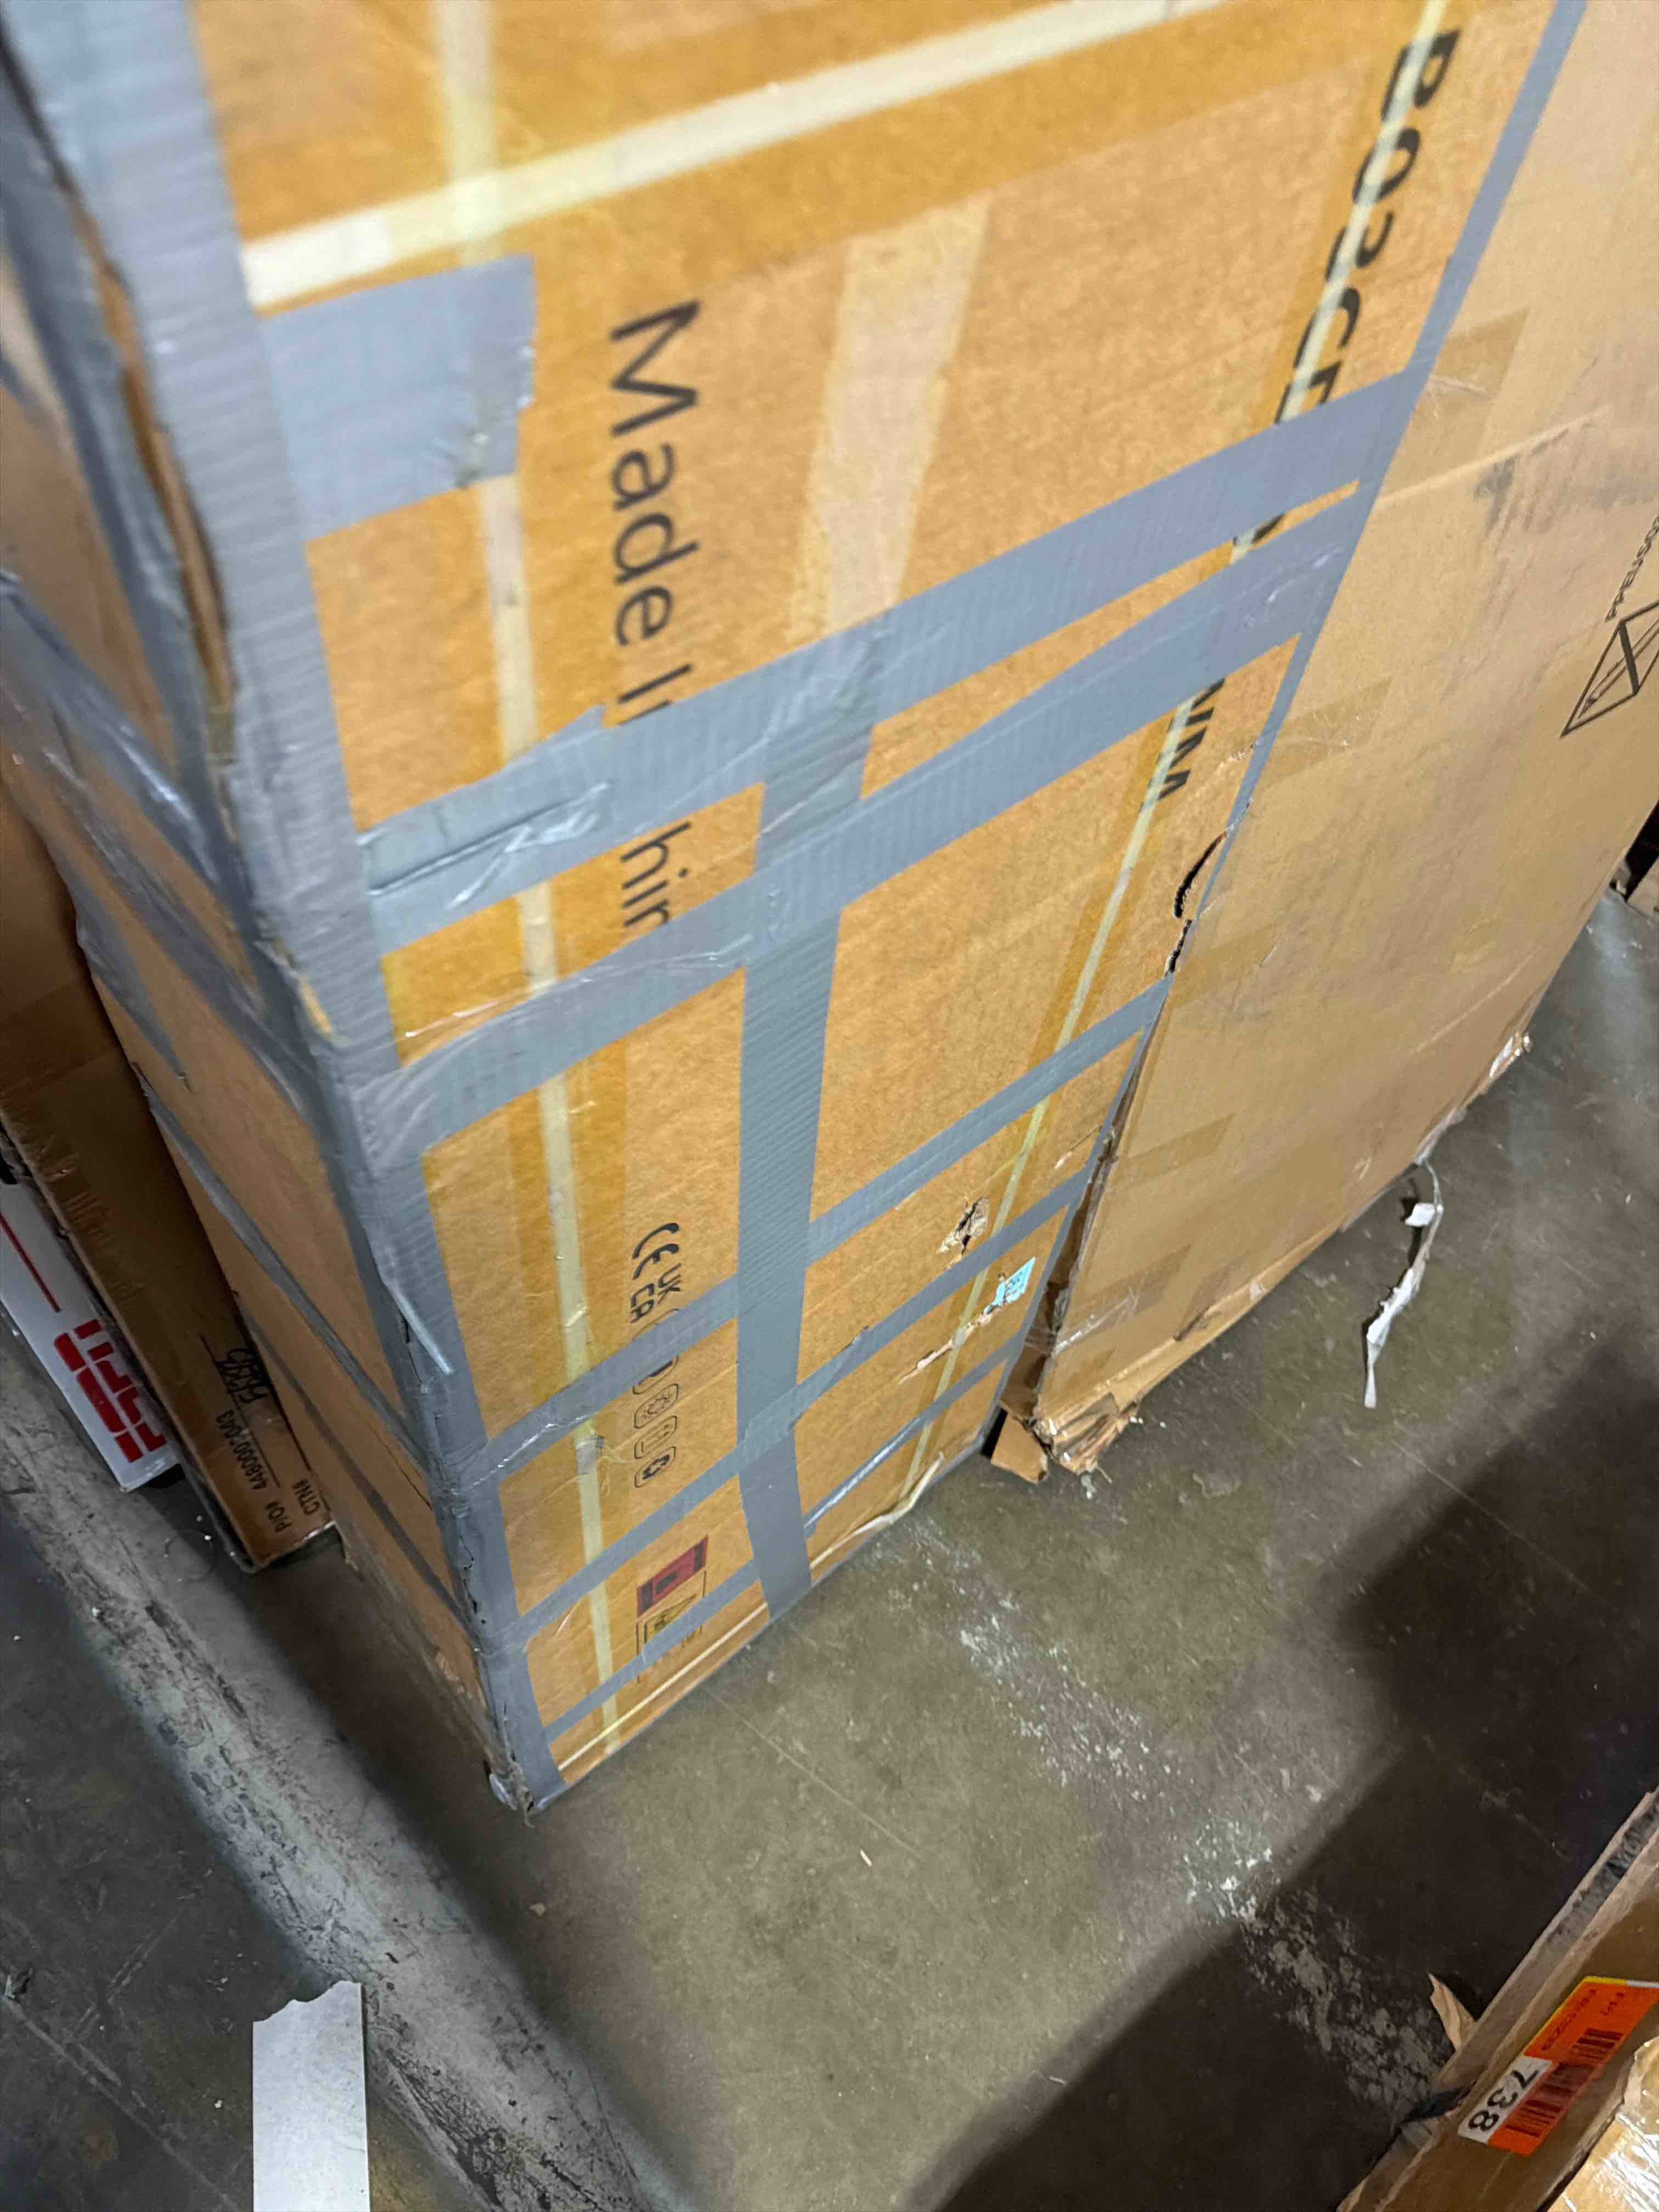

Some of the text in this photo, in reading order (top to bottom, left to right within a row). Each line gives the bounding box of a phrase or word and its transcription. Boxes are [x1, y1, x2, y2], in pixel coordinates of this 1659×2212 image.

[609, 299, 702, 646] Made
[620, 821, 692, 928] hin
[631, 1222, 680, 1280] CE
[1468, 2069, 1539, 2131] 738
